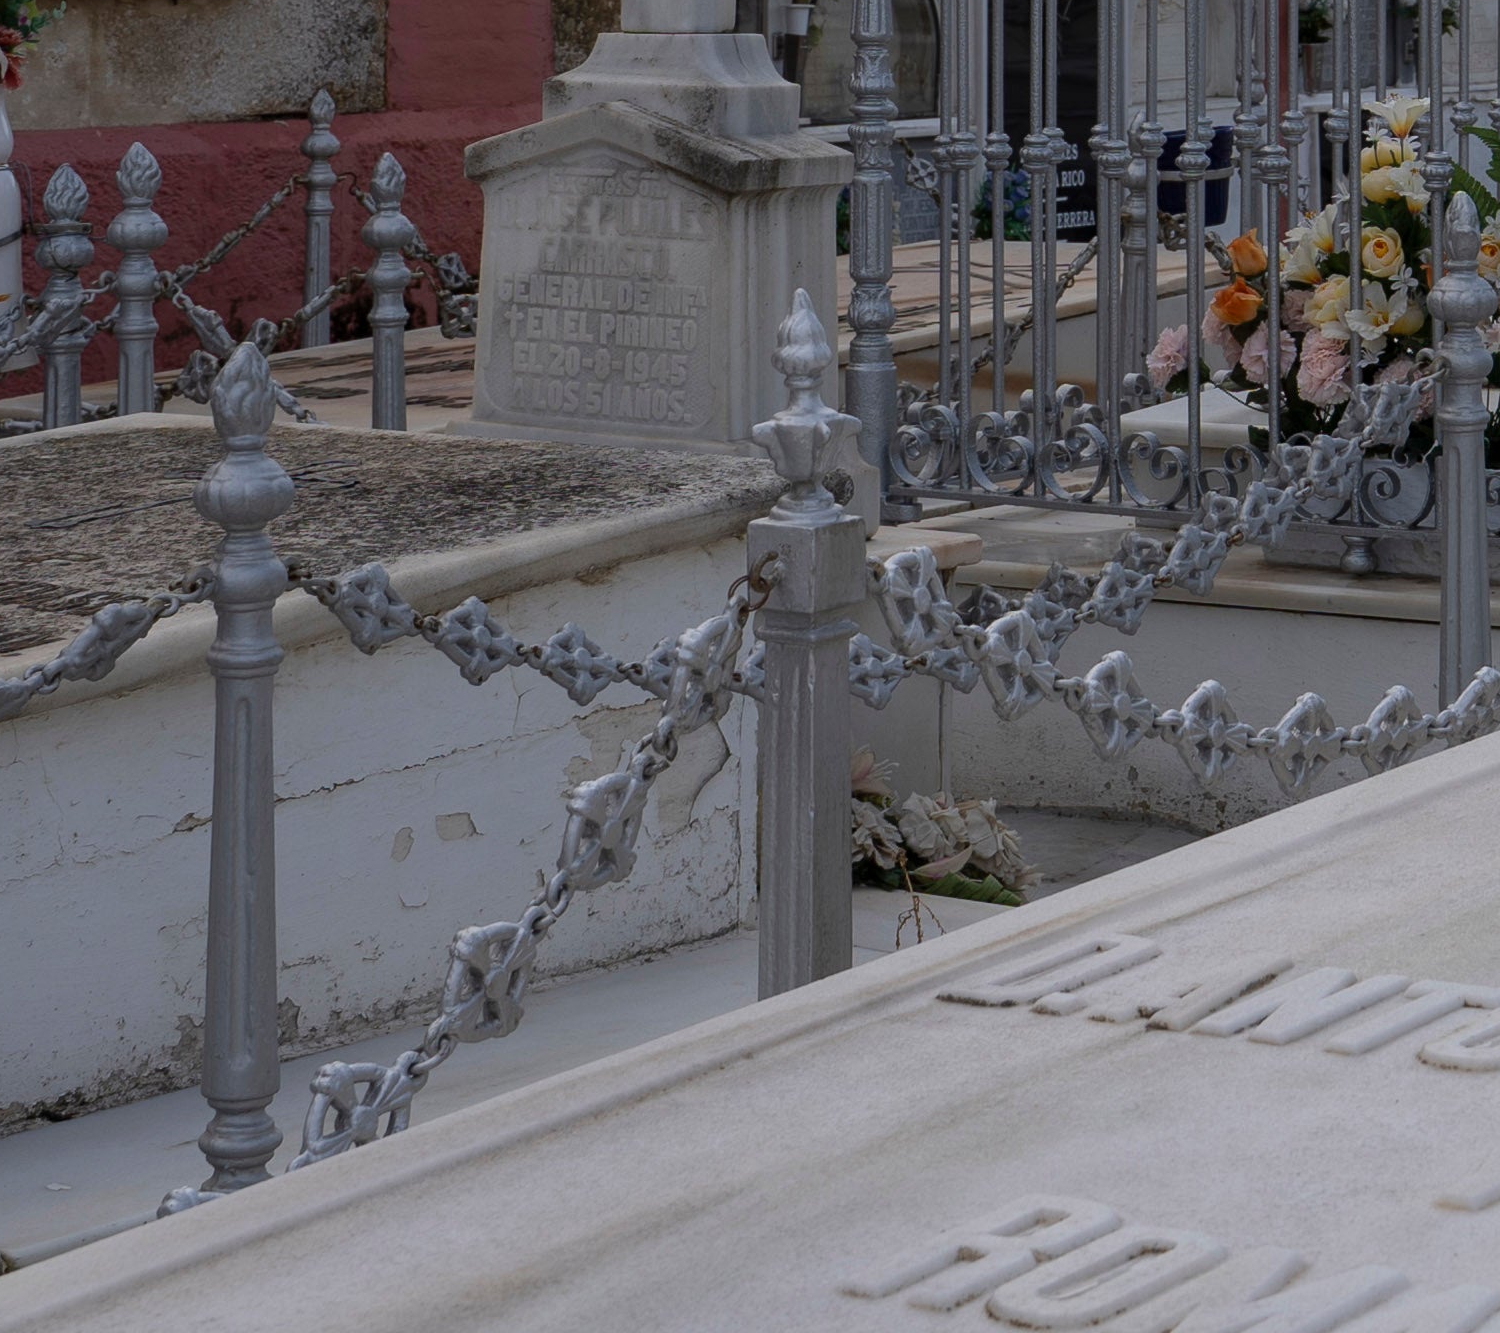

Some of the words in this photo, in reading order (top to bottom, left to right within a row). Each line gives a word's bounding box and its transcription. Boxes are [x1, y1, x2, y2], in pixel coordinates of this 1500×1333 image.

[1061, 169, 1085, 188] RICO
[1056, 210, 1095, 230] ERRERA
[498, 272, 613, 311] GENERAL
[617, 280, 652, 315] DE
[526, 306, 560, 343] EN
[562, 309, 595, 344] EL
[601, 312, 698, 352] PIRINEO
[514, 340, 545, 375] EL
[547, 343, 690, 388] 20-8-1945
[532, 378, 582, 415] LOS
